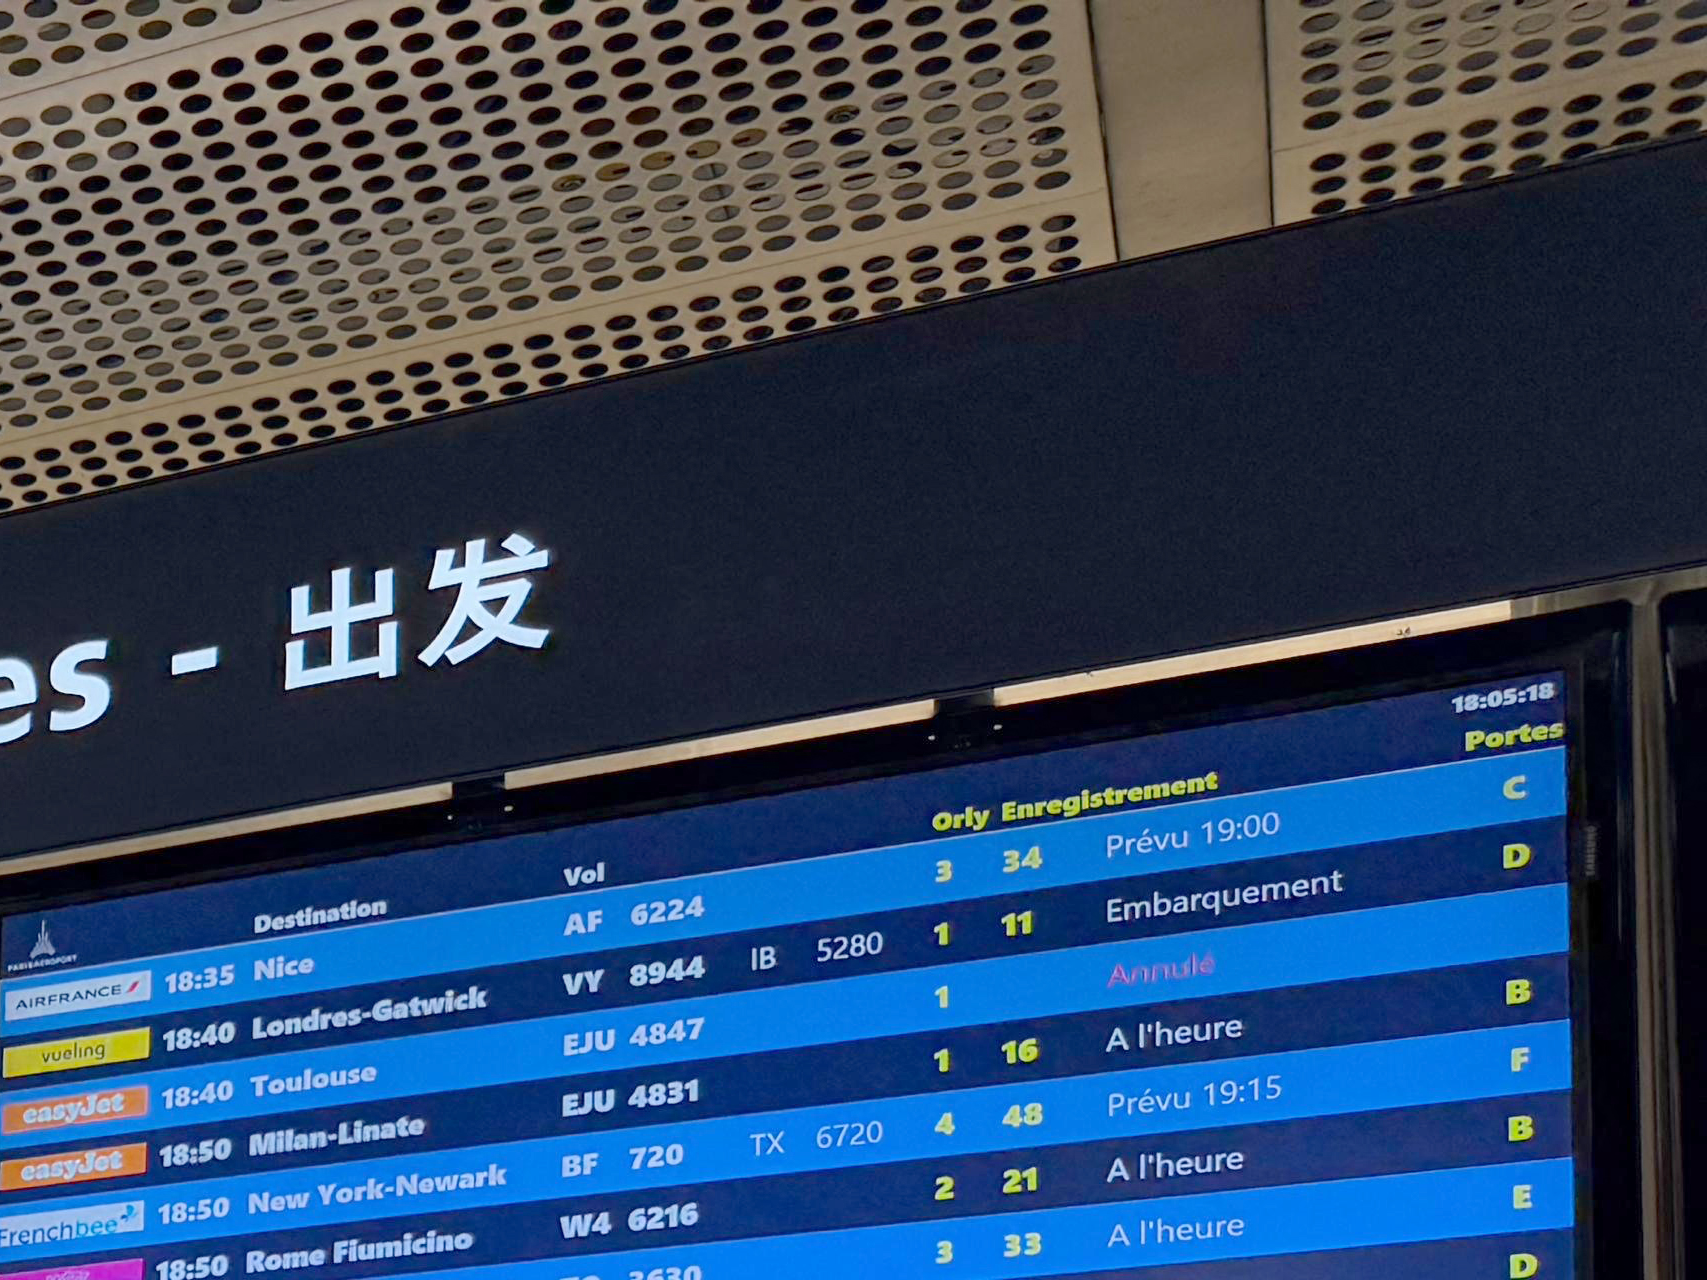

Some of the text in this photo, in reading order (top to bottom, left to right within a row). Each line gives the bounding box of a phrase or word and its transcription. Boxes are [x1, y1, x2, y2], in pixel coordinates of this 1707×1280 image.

[284, 532, 551, 691] 出发
[1452, 682, 1555, 713] 18:05:18
[165, 963, 235, 994] 18:35
[254, 955, 315, 981] Nice
[564, 909, 603, 936] AF
[631, 895, 705, 926] 6224
[935, 859, 953, 883] 3
[1002, 846, 1043, 873] 34
[1107, 828, 1189, 858] Prévu
[1201, 811, 1281, 844] 19:00
[1503, 774, 1528, 800] C
[254, 722, 1564, 934] Destination Vol Orly Enregistrement Portes
[42, 843, 1532, 1067] vueling 18:40 Londres-Gatwick VY 8944 IB 5280 1 11 Embarquement D
[158, 1197, 230, 1224] 18:50
[248, 1191, 310, 1214] New
[318, 1163, 507, 1206] York-Newark
[561, 1152, 599, 1178] BF
[629, 1143, 684, 1170] 720
[749, 1131, 784, 1156] TX
[817, 1120, 883, 1149] 6720
[934, 1112, 956, 1136] 4
[1002, 1102, 1043, 1128] 48
[1108, 1088, 1191, 1117] Prévu
[1204, 1075, 1282, 1105] 19:15
[1511, 1047, 1531, 1072] F
